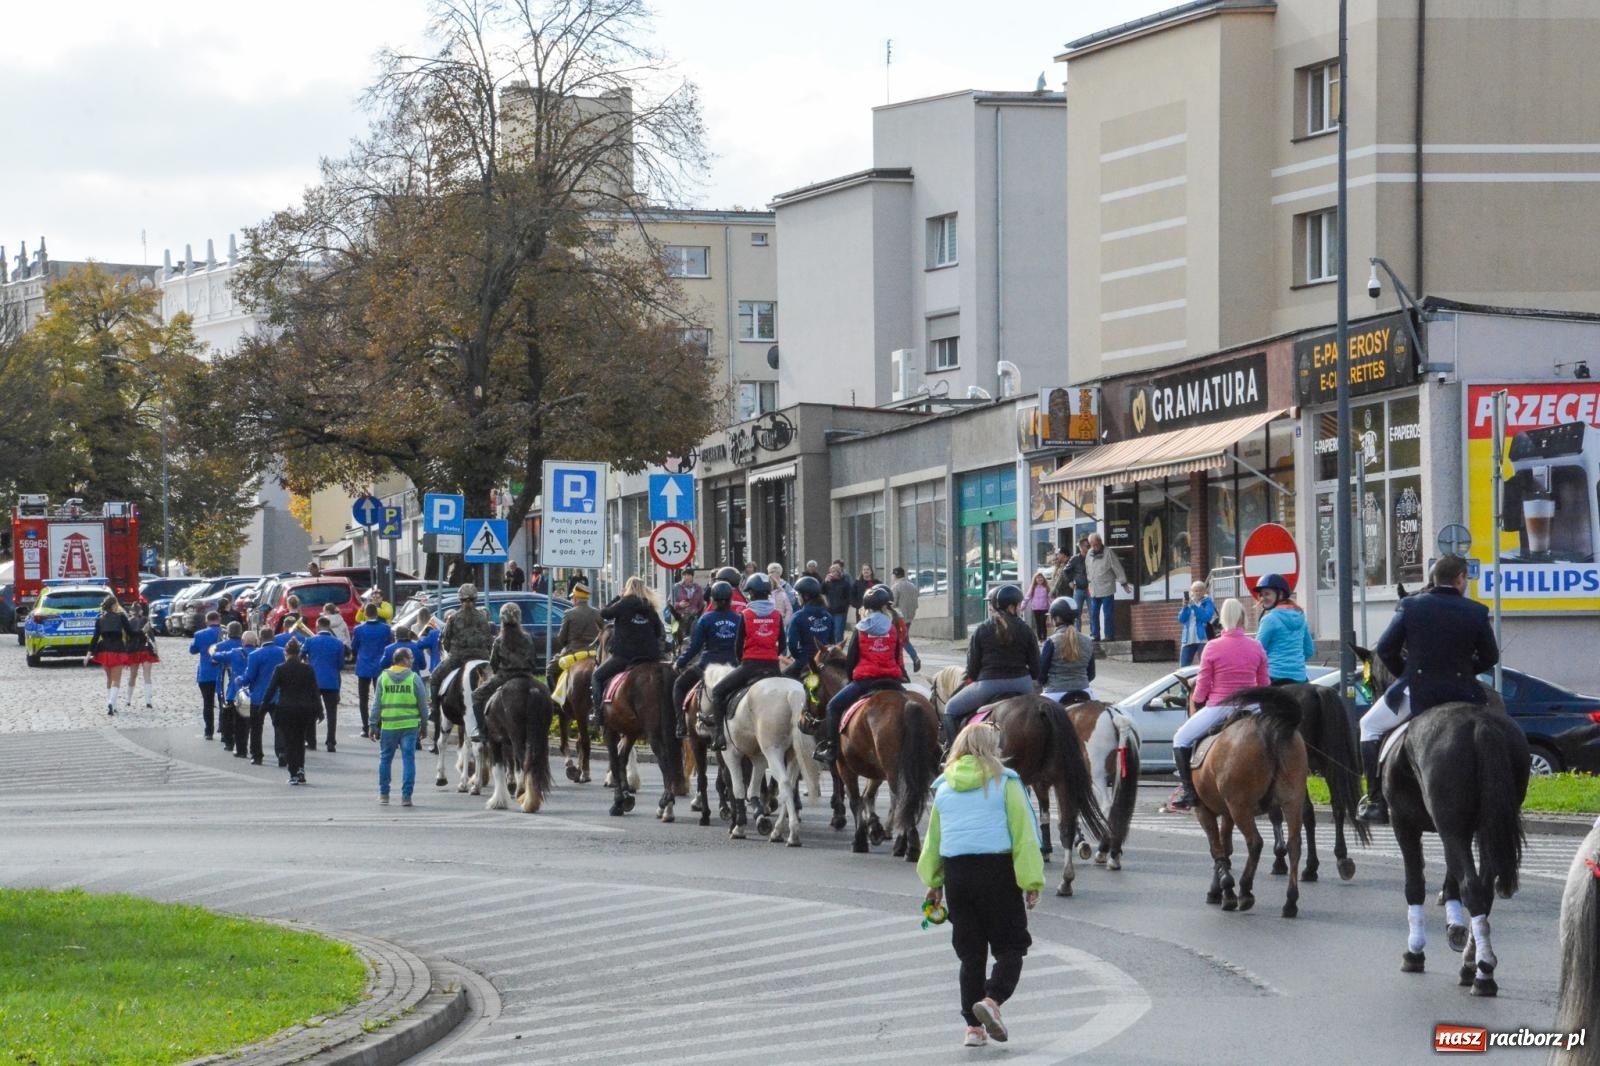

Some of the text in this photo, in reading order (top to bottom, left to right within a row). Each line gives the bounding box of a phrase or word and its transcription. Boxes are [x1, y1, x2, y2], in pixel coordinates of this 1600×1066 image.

[1320, 360, 1385, 391] E-CIRETTES
[1152, 367, 1258, 423] GRAMATURA
[1474, 393, 1600, 427] PRZECE
[563, 474, 588, 507] P
[385, 509, 398, 522] P
[432, 499, 456, 528] P
[656, 538, 688, 557] 3,5t
[1484, 569, 1600, 593] PHILIPS
